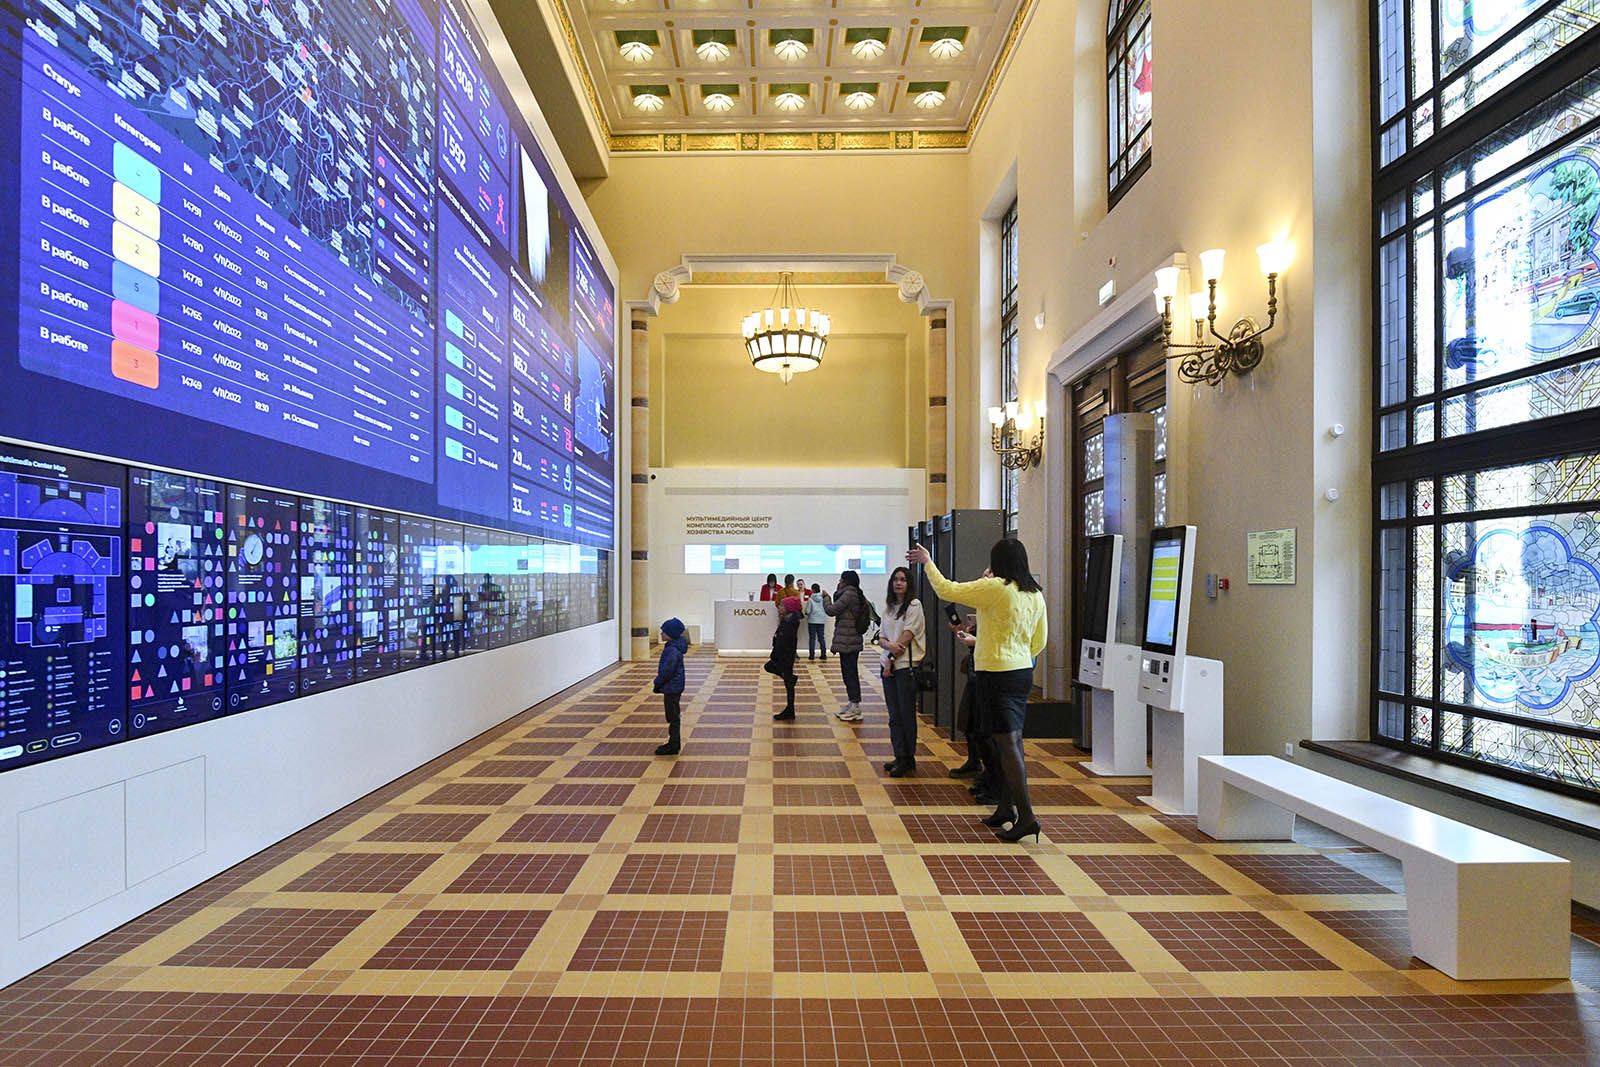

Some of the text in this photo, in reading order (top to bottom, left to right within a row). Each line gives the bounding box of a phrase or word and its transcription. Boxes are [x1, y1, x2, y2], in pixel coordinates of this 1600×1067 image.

[42, 64, 81, 98] Статус
[456, 62, 474, 102] 808
[43, 108, 90, 146] В работе
[42, 150, 90, 188] В работе
[42, 194, 90, 228] В работе
[135, 206, 140, 216] 2
[214, 220, 242, 244] 4/11/2022
[41, 238, 89, 270] В работе
[135, 244, 140, 254] 2
[213, 254, 242, 276] 4/11/2022
[40, 283, 88, 310] В работе
[134, 283, 140, 292] 5
[213, 286, 242, 308] 4/11/2022
[40, 326, 88, 352] В работе
[213, 320, 242, 340] 4/11/2022
[212, 353, 242, 372] 4/11/2022
[212, 386, 242, 404] 4/11/2022
